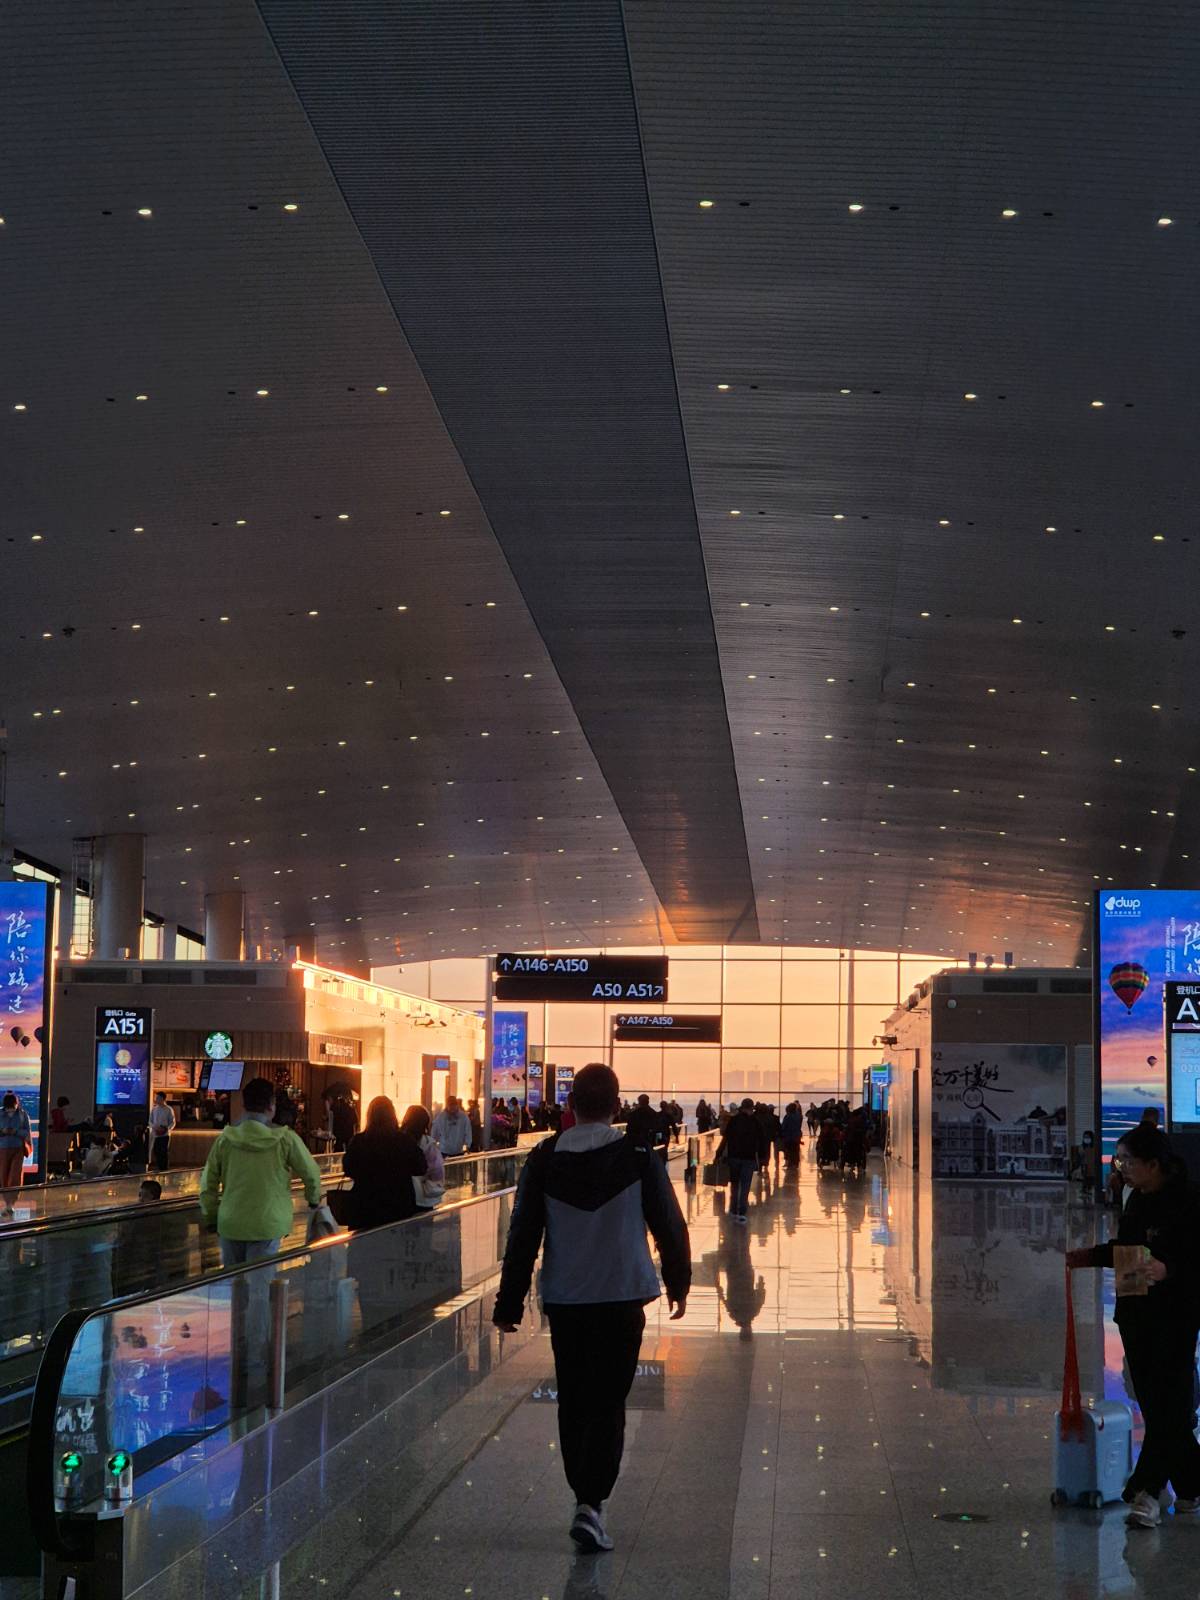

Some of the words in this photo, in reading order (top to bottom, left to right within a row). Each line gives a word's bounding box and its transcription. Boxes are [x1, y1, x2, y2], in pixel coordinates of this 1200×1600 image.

[513, 958, 589, 972] A146-A150
[592, 983, 622, 997] A50
[626, 983, 653, 997] A51
[1176, 998, 1200, 1020] A
[104, 1017, 144, 1035] A151
[627, 1016, 673, 1026] A147-A150
